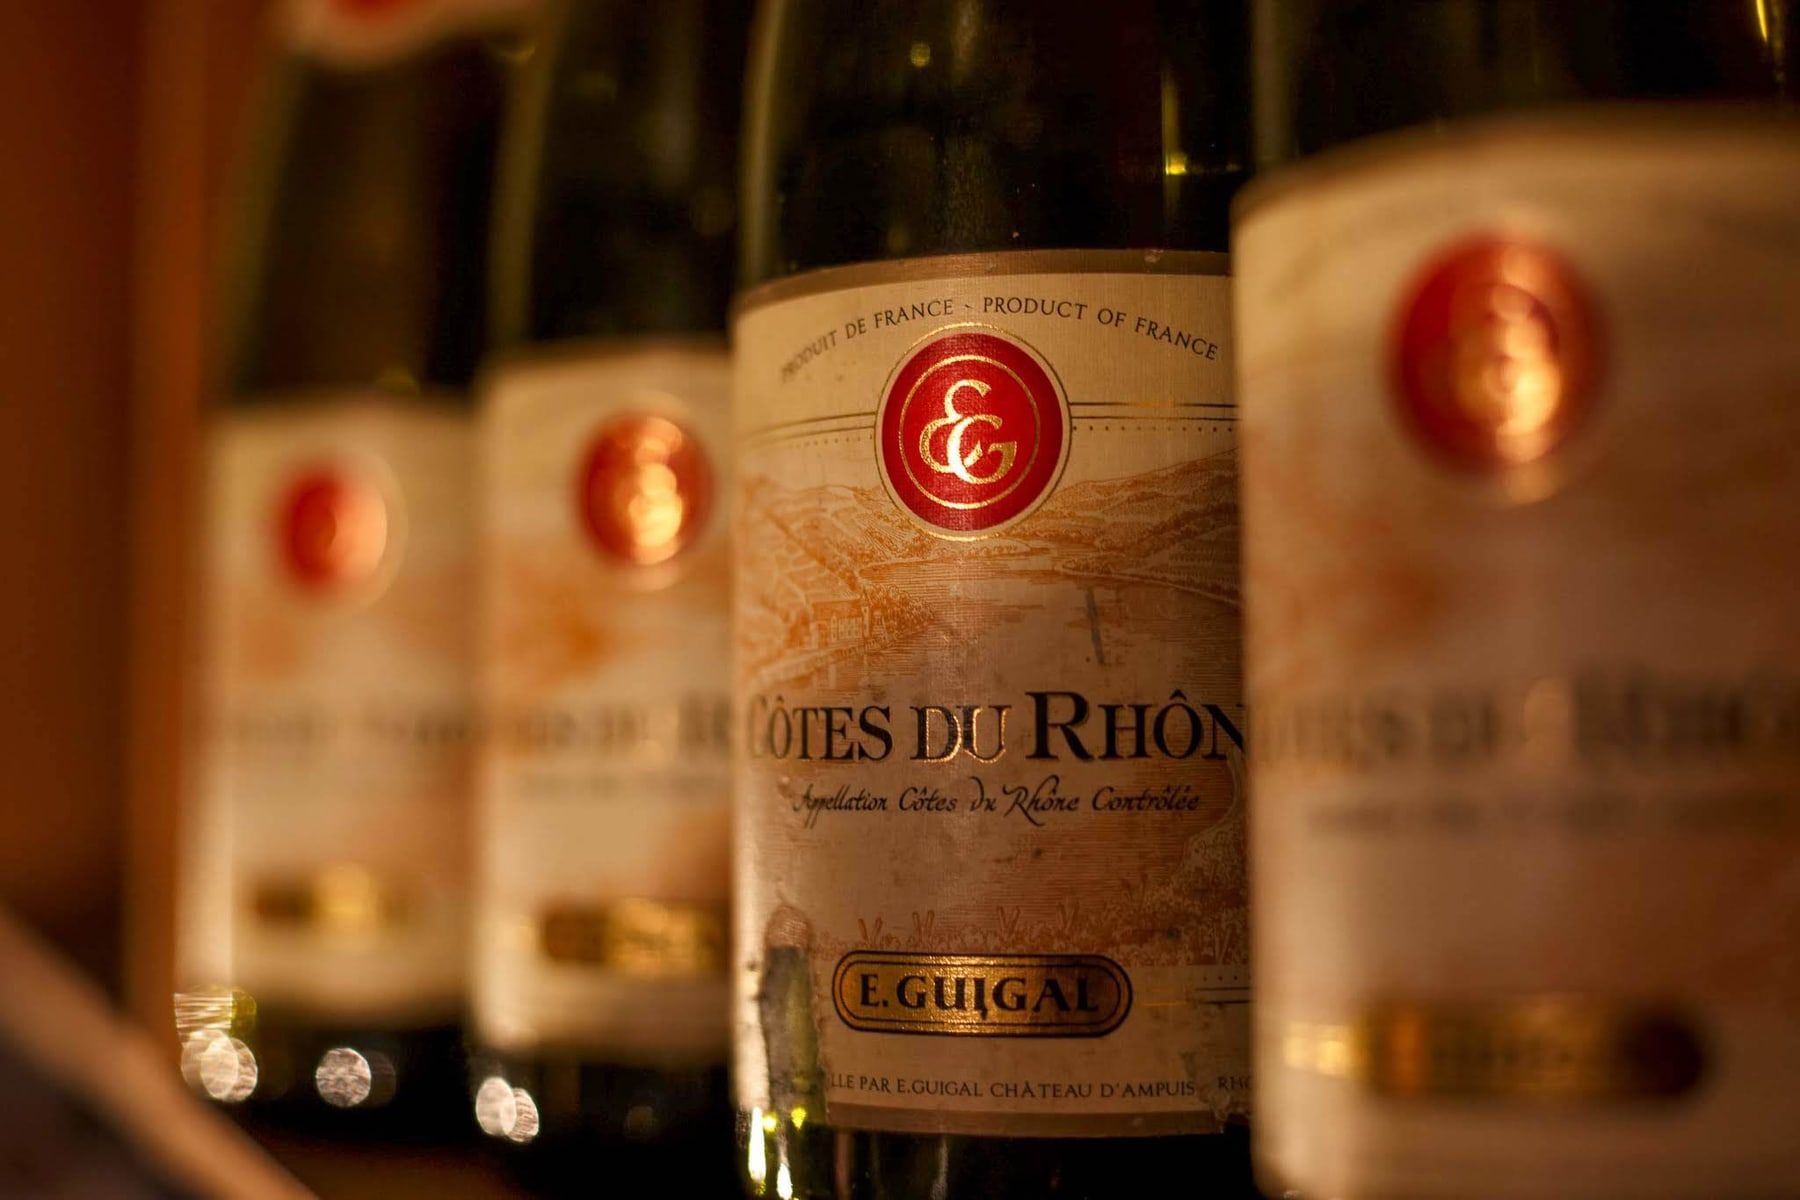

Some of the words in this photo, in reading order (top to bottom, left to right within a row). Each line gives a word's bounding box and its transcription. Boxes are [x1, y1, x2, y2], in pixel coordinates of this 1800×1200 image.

[845, 318, 867, 339] DE
[873, 299, 954, 329] FRANCE
[983, 297, 1088, 320] PRODUCT
[1097, 307, 1127, 327] OF
[1134, 316, 1218, 360] FRANCE
[748, 694, 893, 762] CÔTES
[909, 704, 1012, 764] DU
[793, 783, 888, 829] Appellation
[898, 786, 958, 813] Côtes
[968, 775, 998, 812] du
[1002, 774, 1080, 827] Rhône
[1091, 785, 1200, 812] Contrôlée
[859, 1076, 892, 1094] PAR
[896, 1078, 984, 1098] E.GUIGAL
[990, 1080, 1092, 1099] CHÂTEAU
[1100, 1080, 1197, 1099] D'AMPUIS
